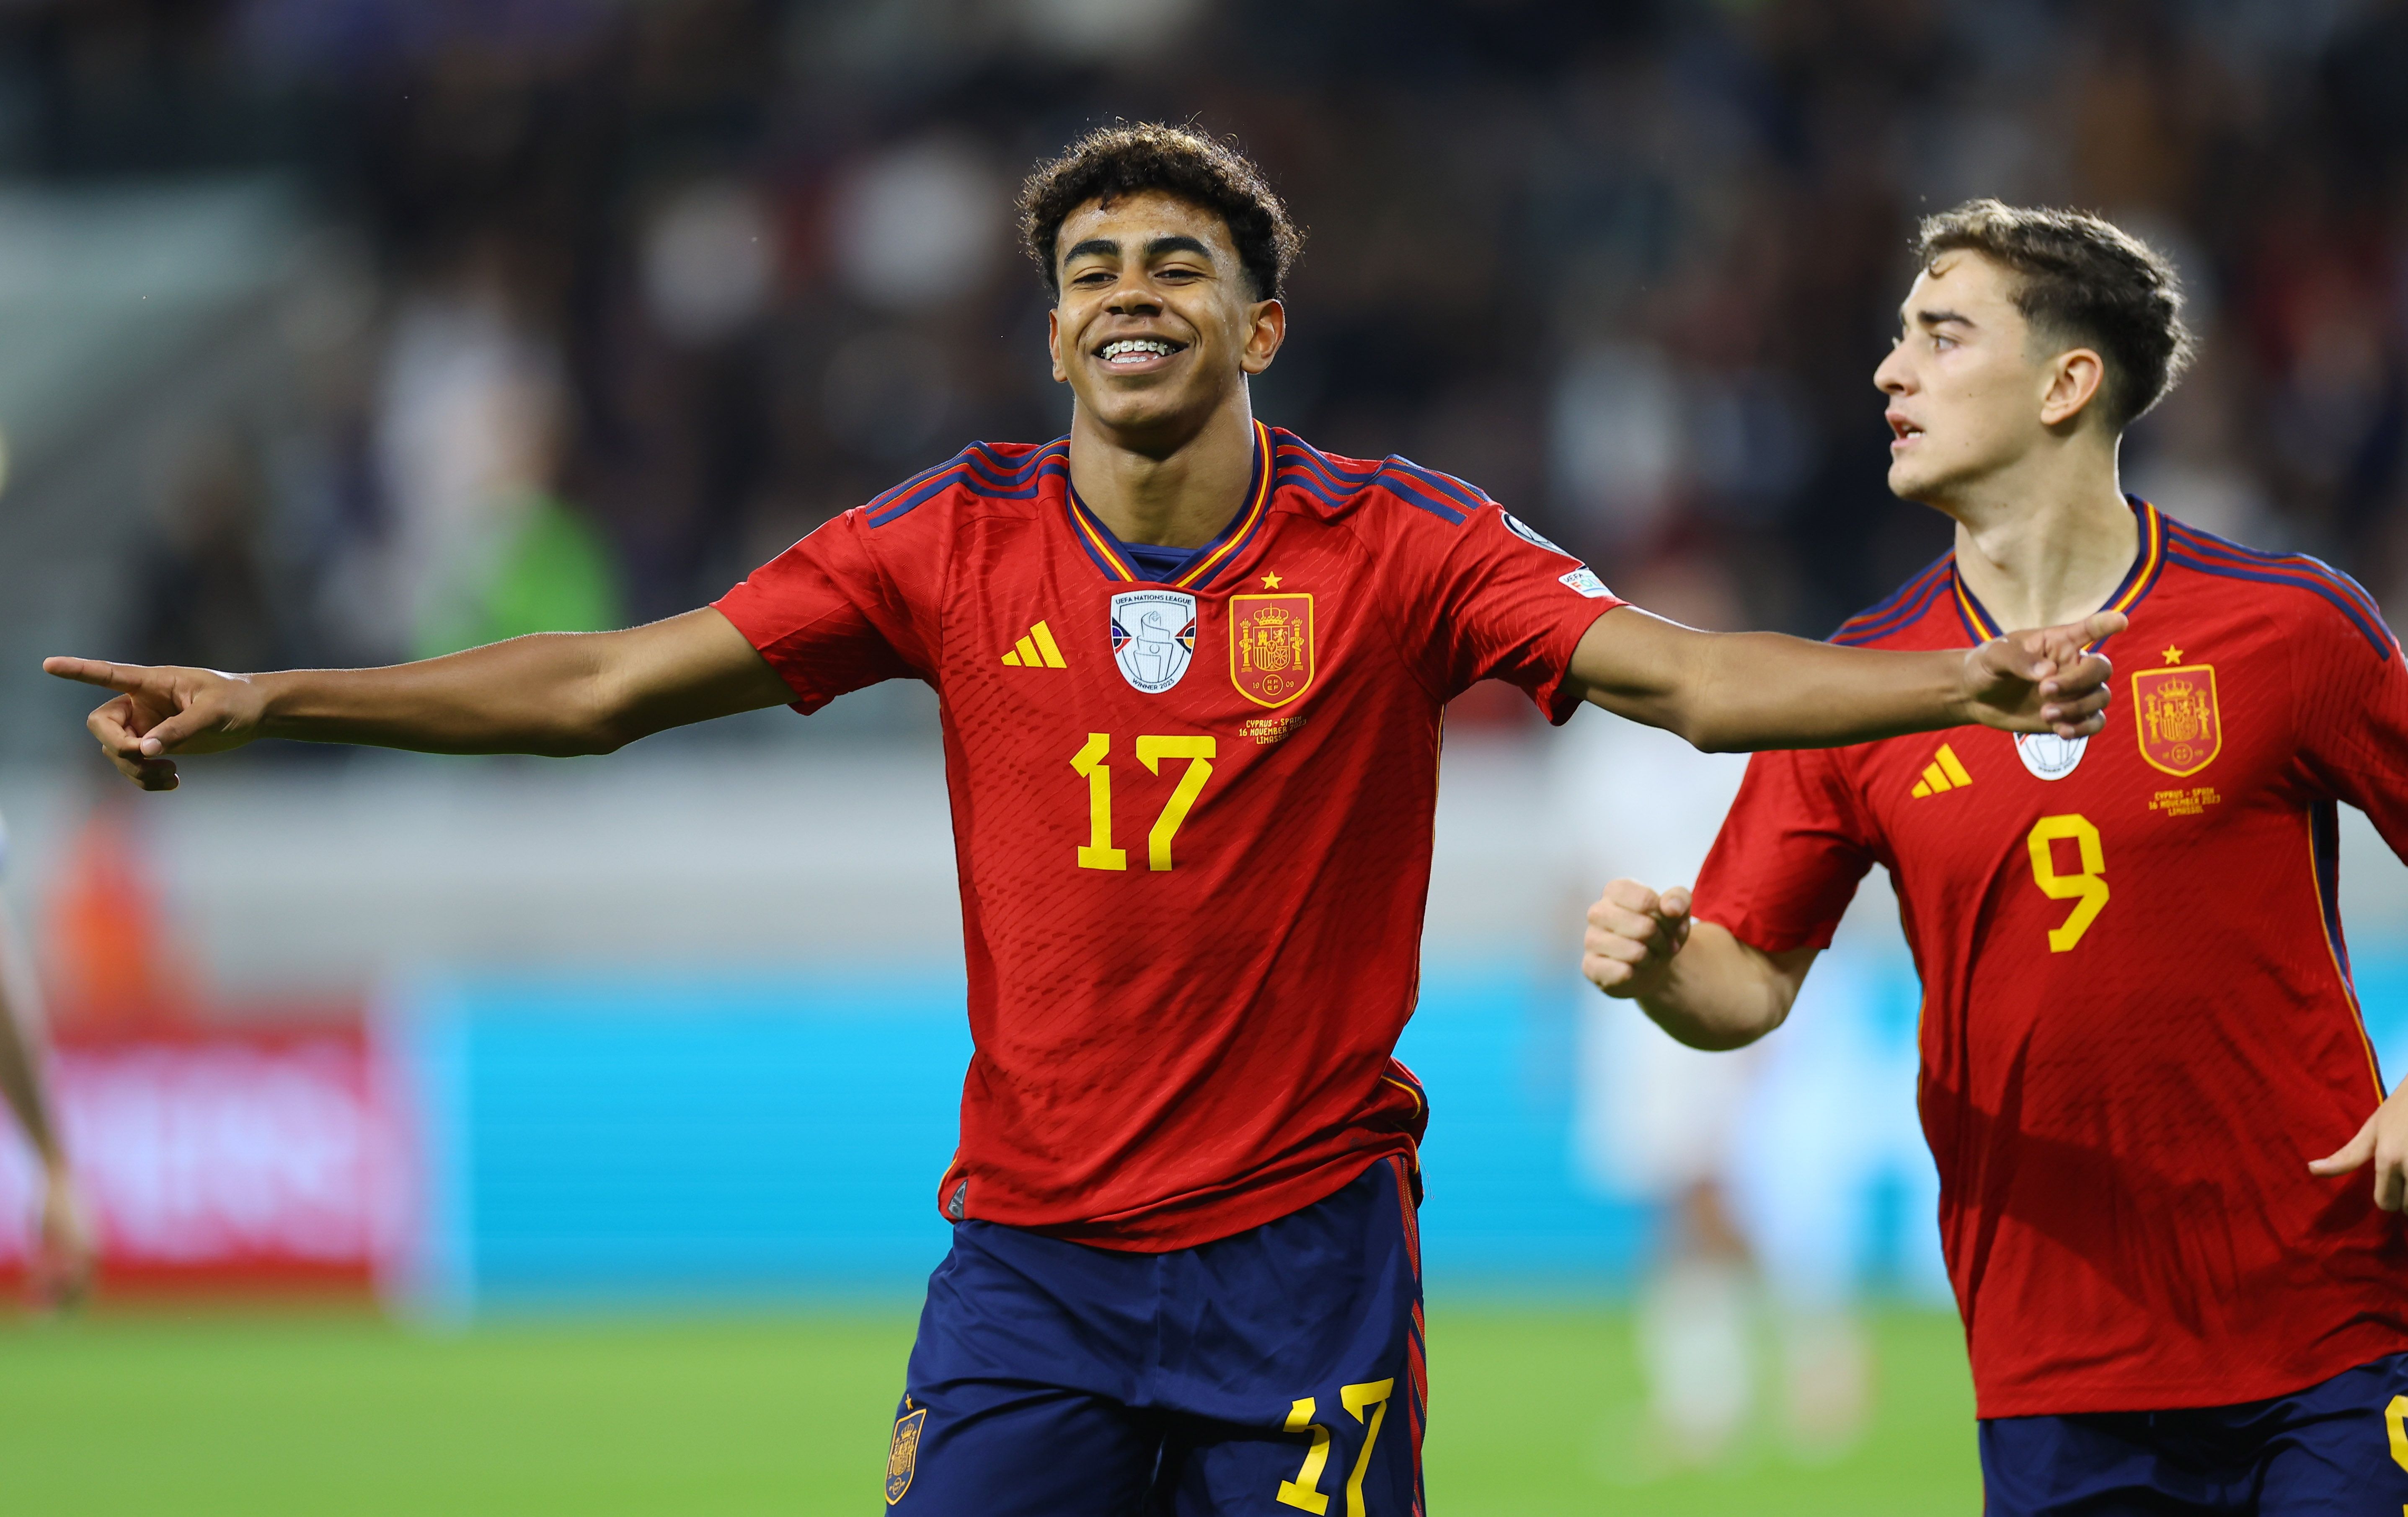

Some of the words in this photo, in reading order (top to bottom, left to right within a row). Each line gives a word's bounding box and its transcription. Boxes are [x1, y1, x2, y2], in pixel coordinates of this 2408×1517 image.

[1165, 595, 1191, 605] LEAGUE
[1133, 678, 1157, 690] WINNER
[1159, 678, 1174, 689] 2023
[1246, 720, 1272, 728] CYPRUS
[1280, 716, 1302, 726] SPAIN
[1250, 726, 1287, 736] NOVEMBER
[1290, 719, 1307, 731] 2023
[1069, 733, 1216, 871] 17
[2027, 813, 2110, 953] 9
[1276, 1377, 1394, 1517] 17
